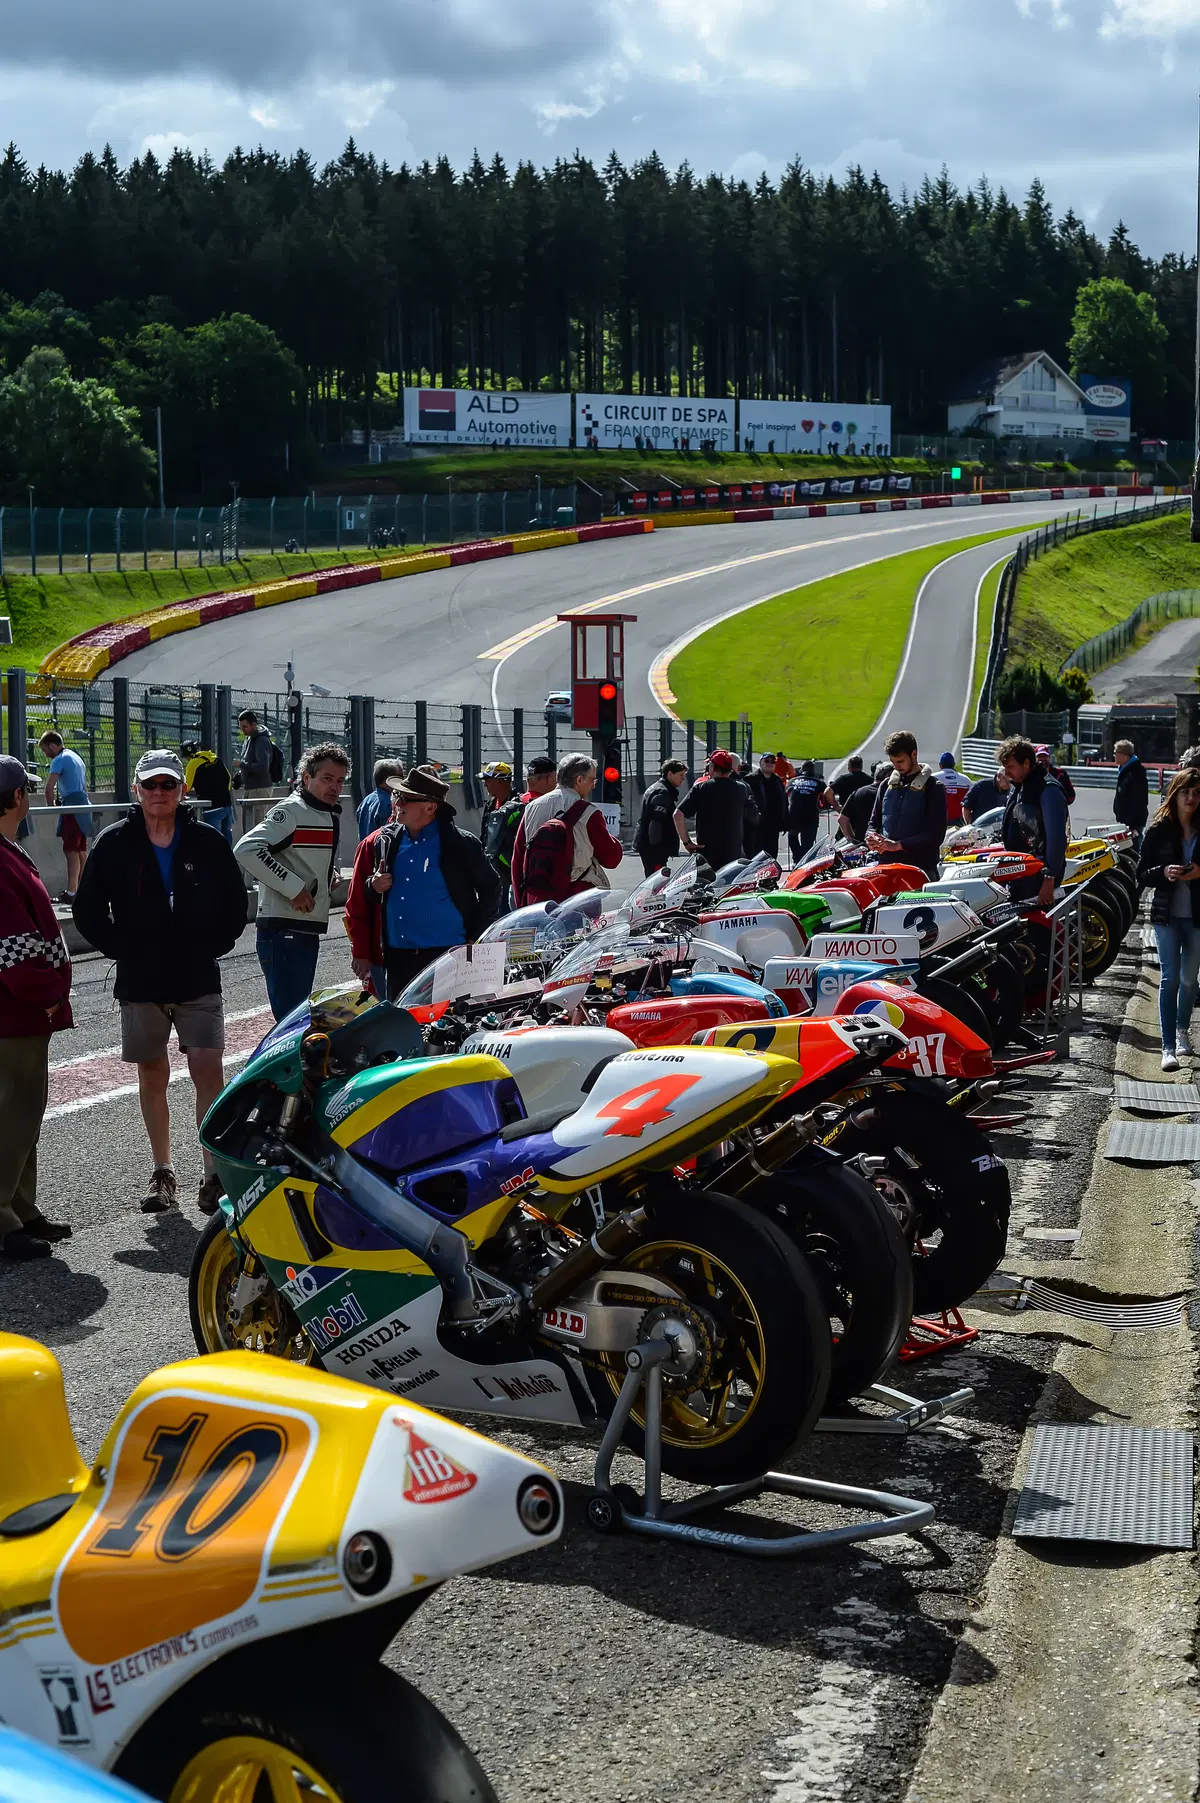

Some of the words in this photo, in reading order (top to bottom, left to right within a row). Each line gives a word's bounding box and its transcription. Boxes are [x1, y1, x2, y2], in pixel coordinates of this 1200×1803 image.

[467, 395, 519, 414] ALD
[604, 405, 667, 421] CIRCUIT
[672, 407, 692, 422] DE
[697, 408, 728, 424] SPA
[467, 418, 557, 435] Automotive
[604, 424, 729, 441] FRANCORCHAMPS
[747, 422, 764, 430] Feel
[765, 423, 797, 432] inspired
[499, 437, 557, 445] TGETHER
[604, 815, 616, 825] XIT
[256, 847, 289, 881] YAMAHA
[642, 903, 667, 913] SPIDI
[719, 916, 758, 931] YAMAHA
[903, 906, 939, 949] 3
[825, 939, 897, 957] YAMOTO
[821, 974, 855, 996] elf
[630, 1011, 661, 1021] YAMAHA
[464, 1043, 512, 1059] YAMAHA
[907, 1033, 947, 1078] 37
[329, 1097, 364, 1129] HONDA
[595, 1073, 704, 1140] 4
[237, 1175, 267, 1218] NSR
[305, 1292, 368, 1350] Mobil
[335, 1318, 411, 1366] HONDA
[403, 1446, 455, 1487] HB
[85, 1412, 289, 1564] 10
[85, 1669, 116, 1716] LS
[111, 1630, 199, 1687] ELECTRONICS
[201, 1614, 259, 1650] COMPUTERS
